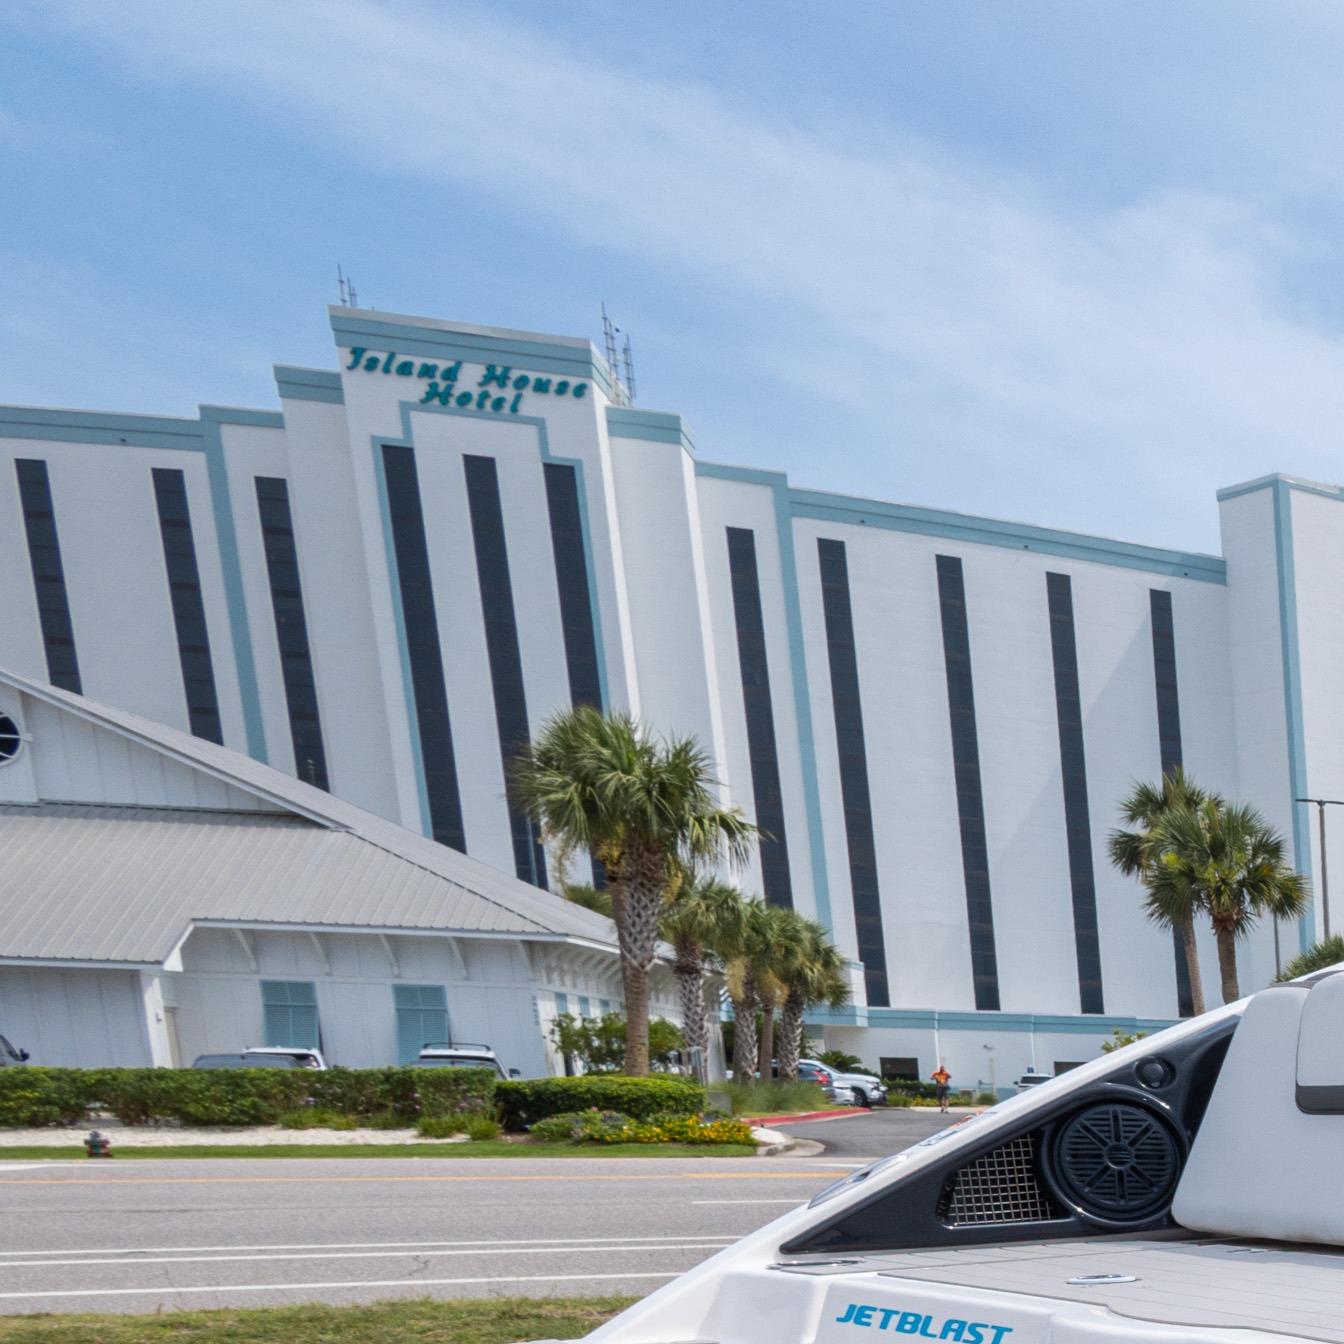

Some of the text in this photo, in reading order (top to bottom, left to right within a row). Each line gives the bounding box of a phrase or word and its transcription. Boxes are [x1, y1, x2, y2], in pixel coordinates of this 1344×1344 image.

[346, 347, 588, 398] Island House
[420, 381, 523, 414] Hotel
